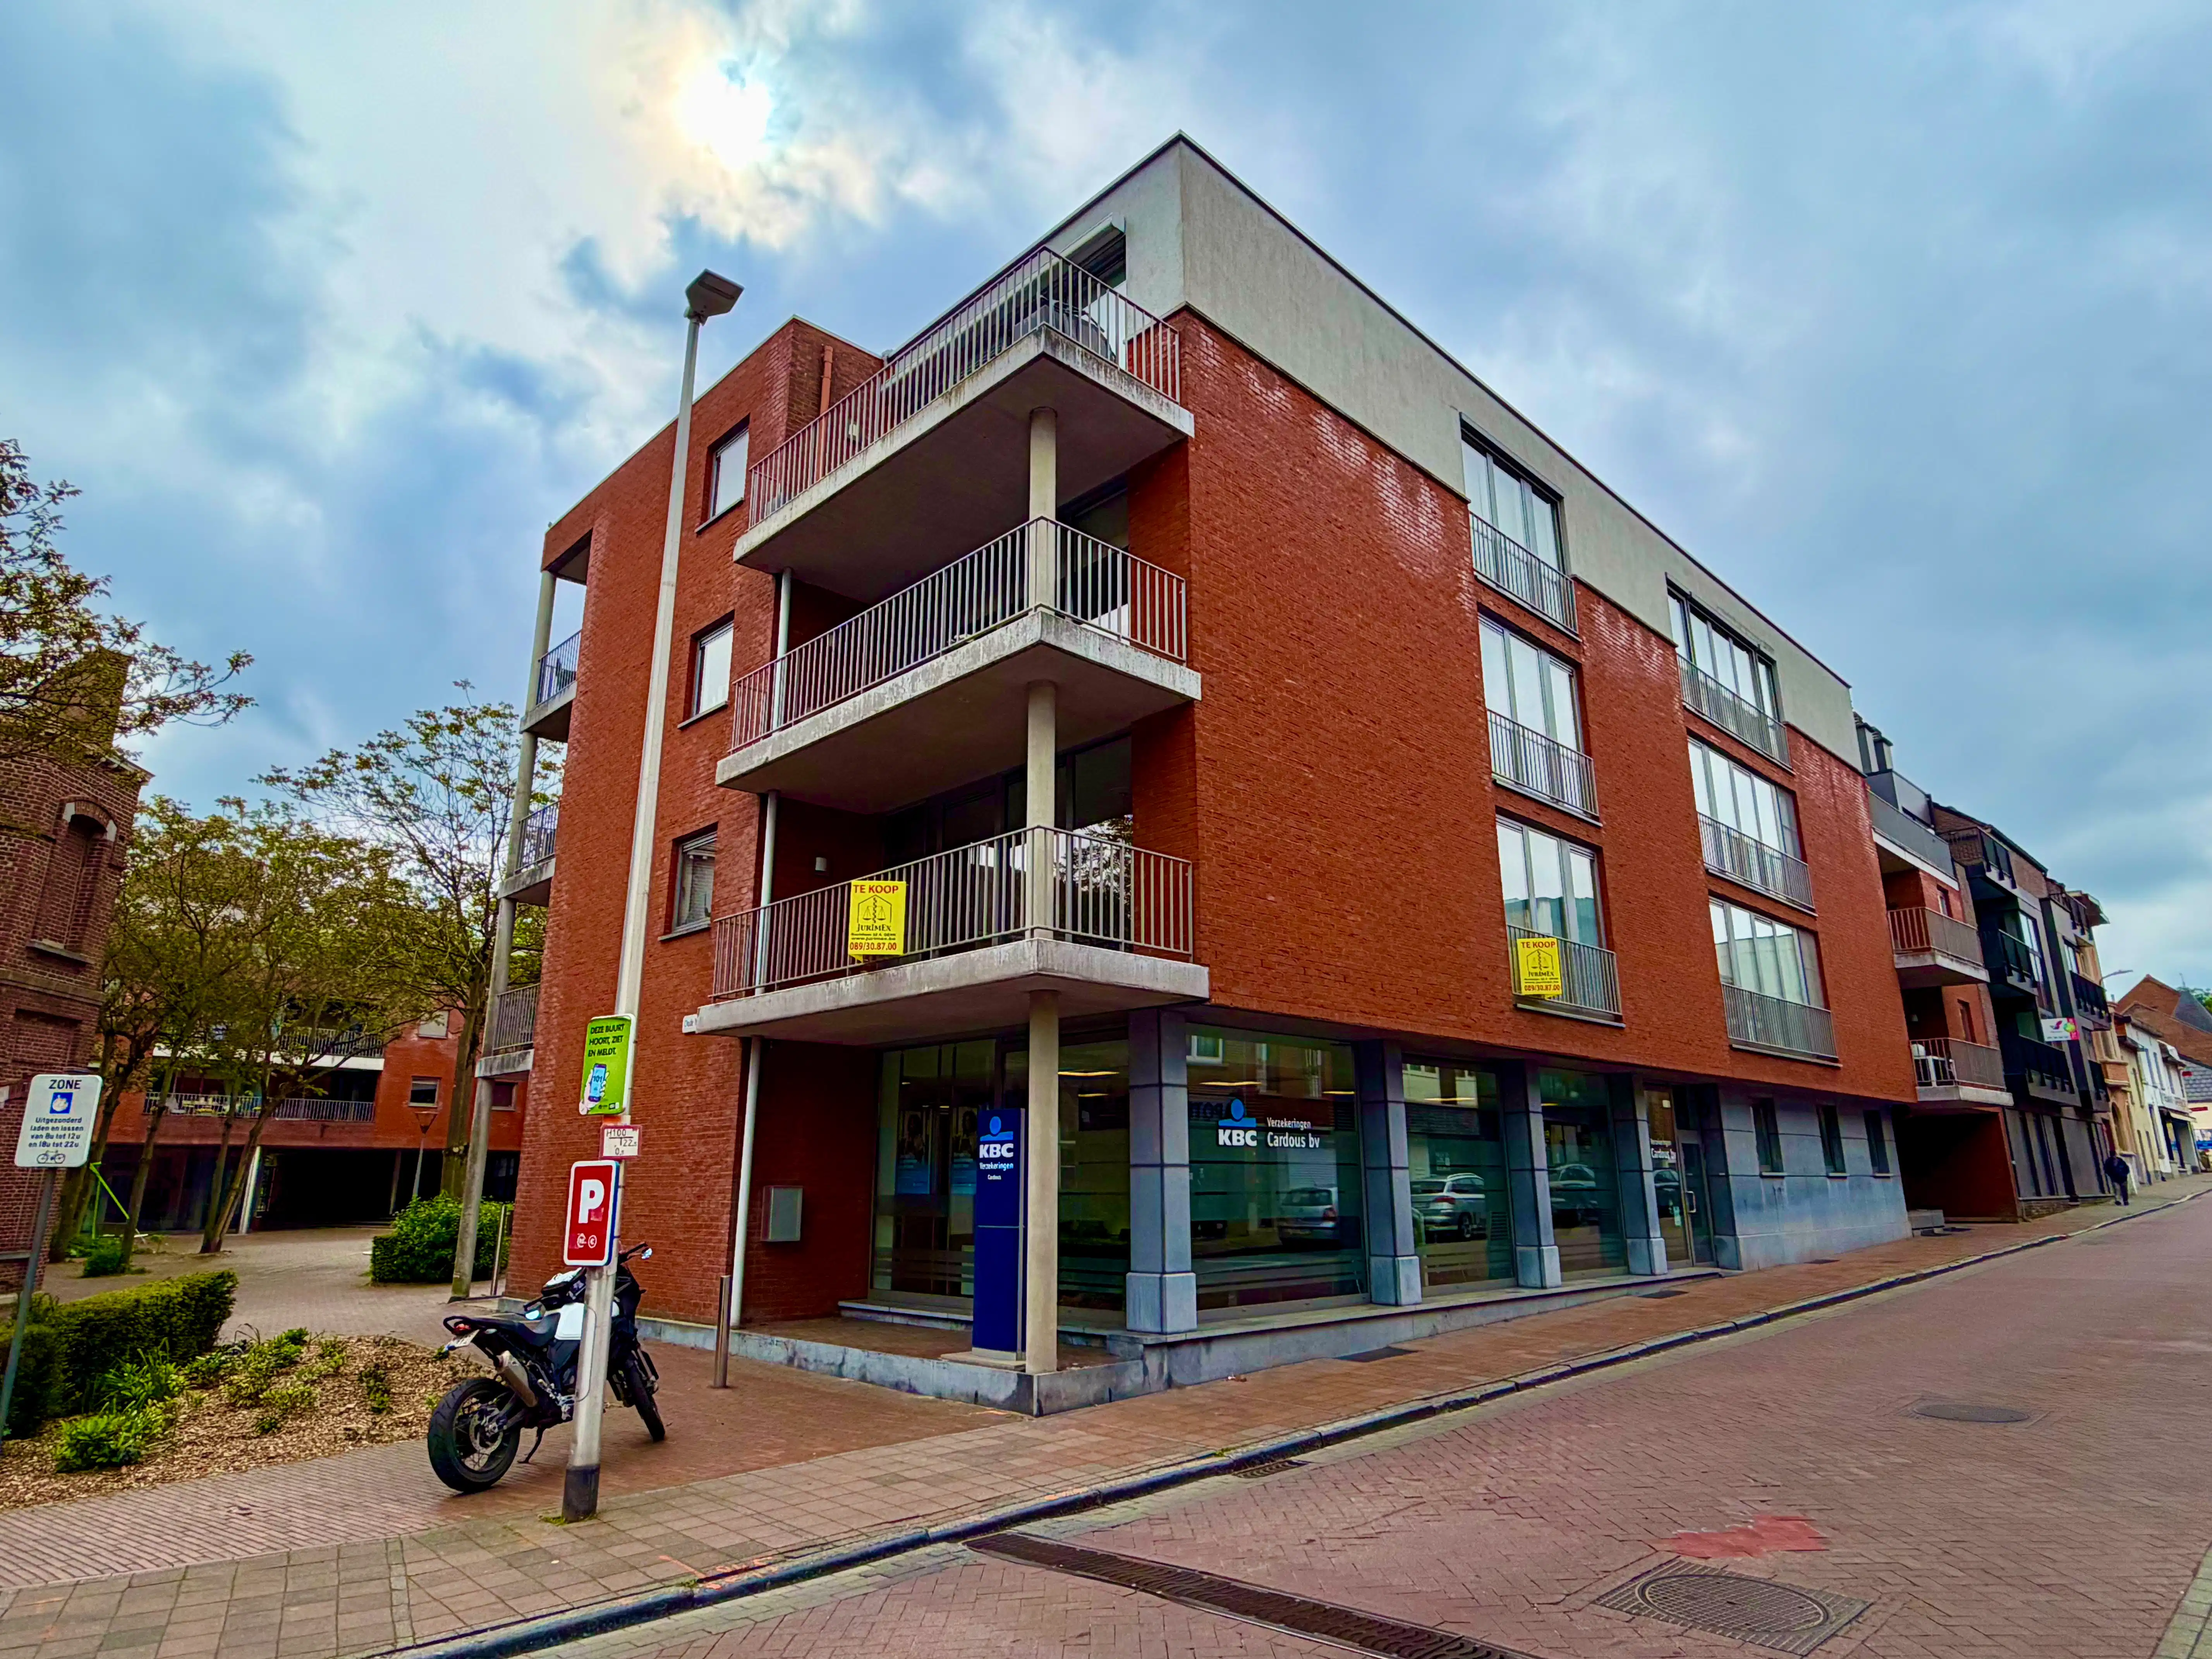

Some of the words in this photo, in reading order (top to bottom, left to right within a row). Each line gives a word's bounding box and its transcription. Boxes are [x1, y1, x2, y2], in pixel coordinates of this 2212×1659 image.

[853, 884, 866, 893] TE
[869, 884, 898, 894] KOOP
[850, 941, 896, 951] 089/30.87.00
[591, 1026, 604, 1034] DEZE
[605, 1024, 625, 1032] BUURT
[589, 1037, 610, 1045] HOORT,
[48, 1080, 82, 1089] ZONE
[1267, 1117, 1311, 1130] Verzekeringen
[1218, 1129, 1257, 1146] KBC
[1267, 1132, 1305, 1147] Cardous
[1309, 1133, 1320, 1148] bv
[979, 1143, 1013, 1158] KBC
[578, 1179, 605, 1223] P
